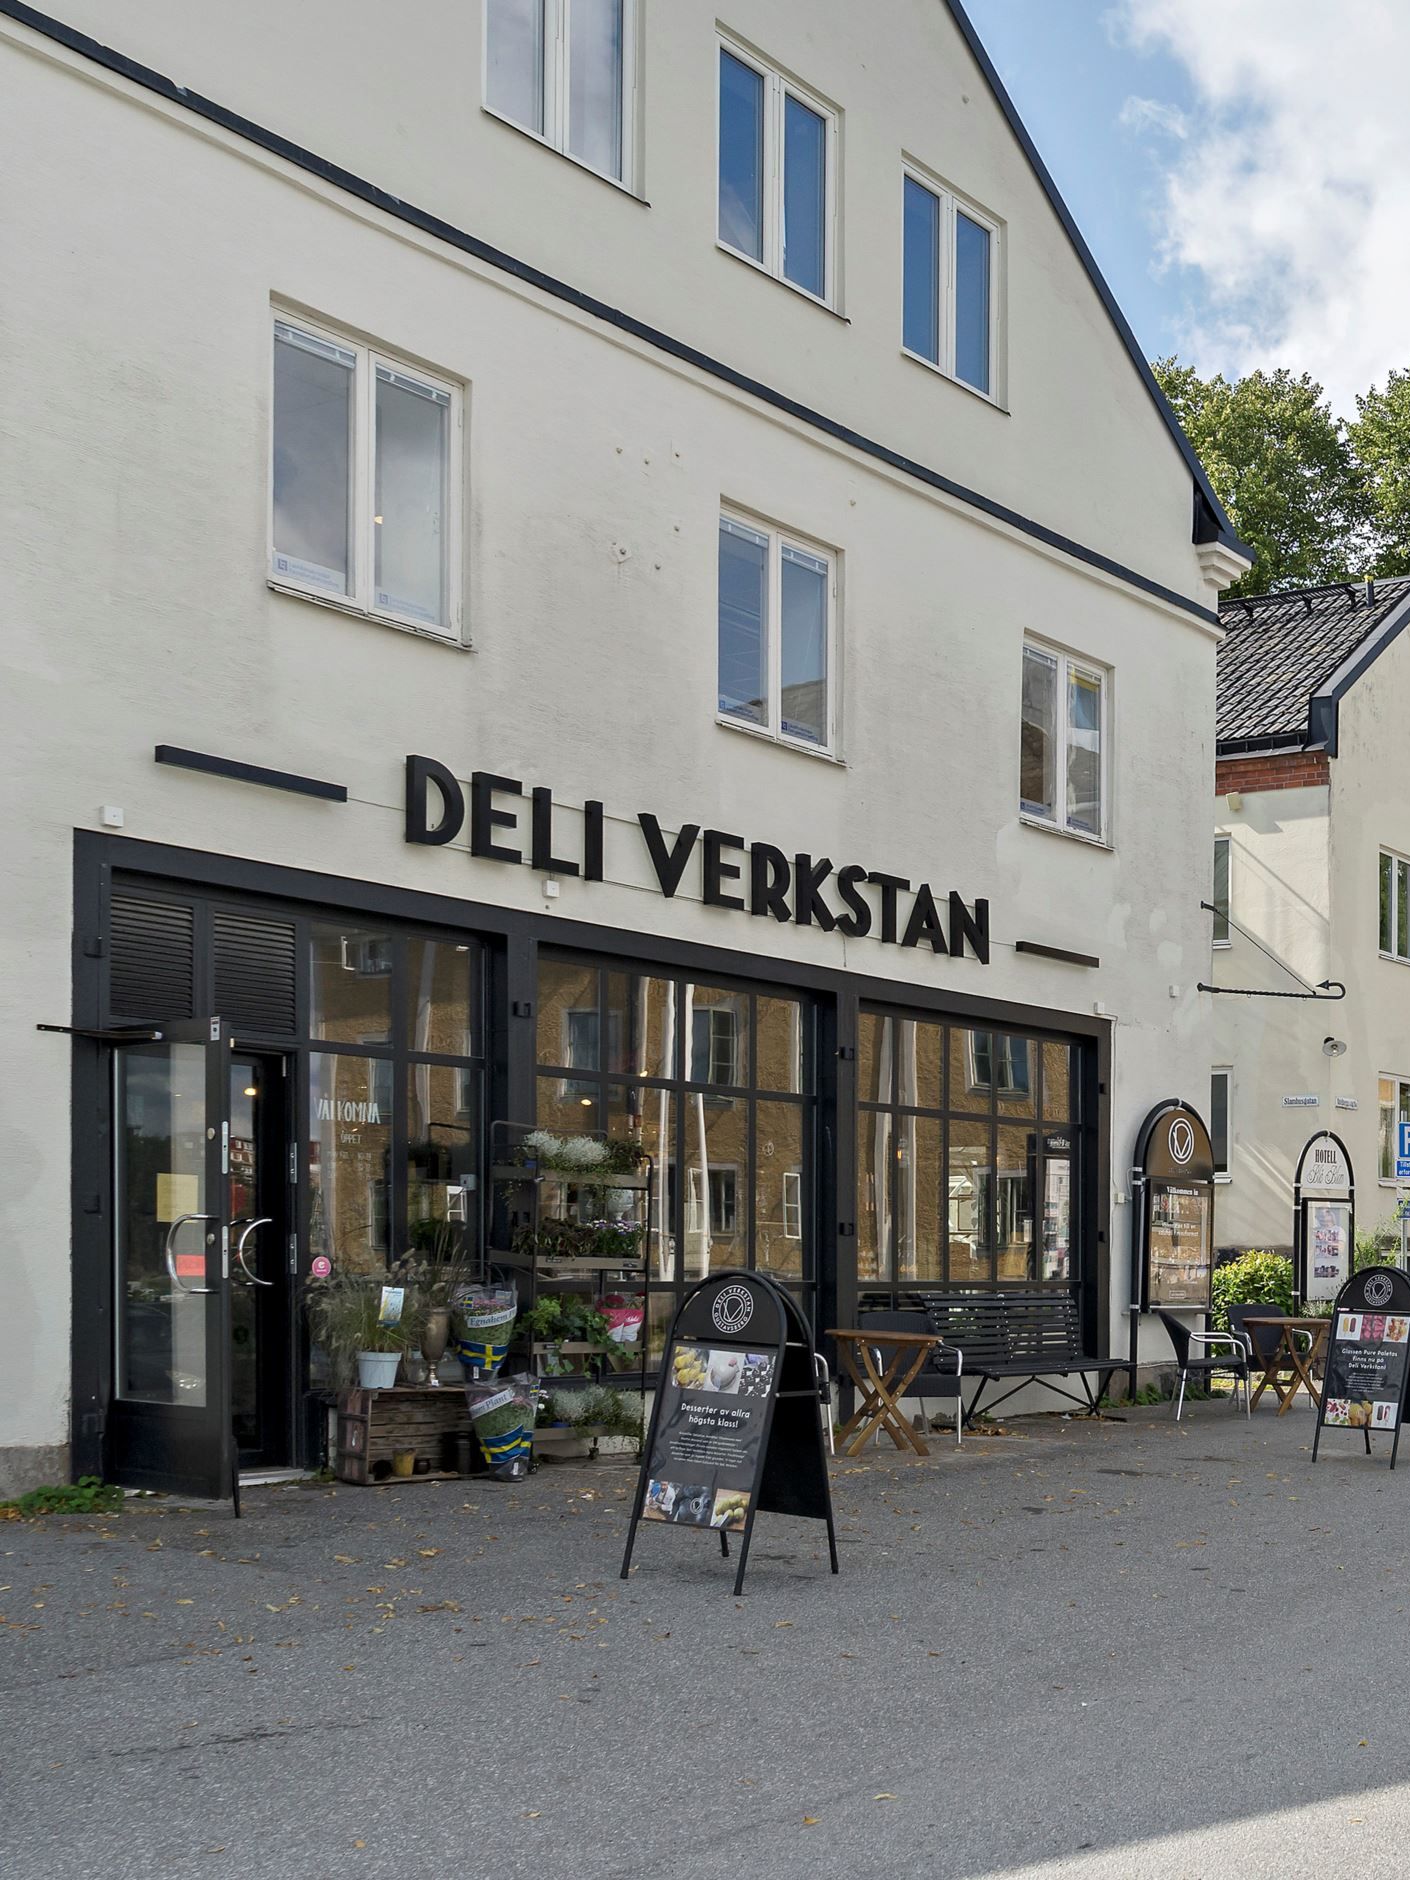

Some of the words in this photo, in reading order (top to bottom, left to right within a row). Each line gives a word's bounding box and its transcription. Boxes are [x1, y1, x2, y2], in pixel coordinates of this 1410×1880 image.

[405, 754, 603, 882] DELI
[637, 812, 990, 965] VERKSTAN
[1315, 1149, 1337, 1163] HOTELL
[680, 1402, 718, 1414] Desserter
[719, 1408, 730, 1416] av
[731, 1408, 751, 1418] allra
[688, 1414, 716, 1426] högsta
[717, 1417, 739, 1429] klass!
